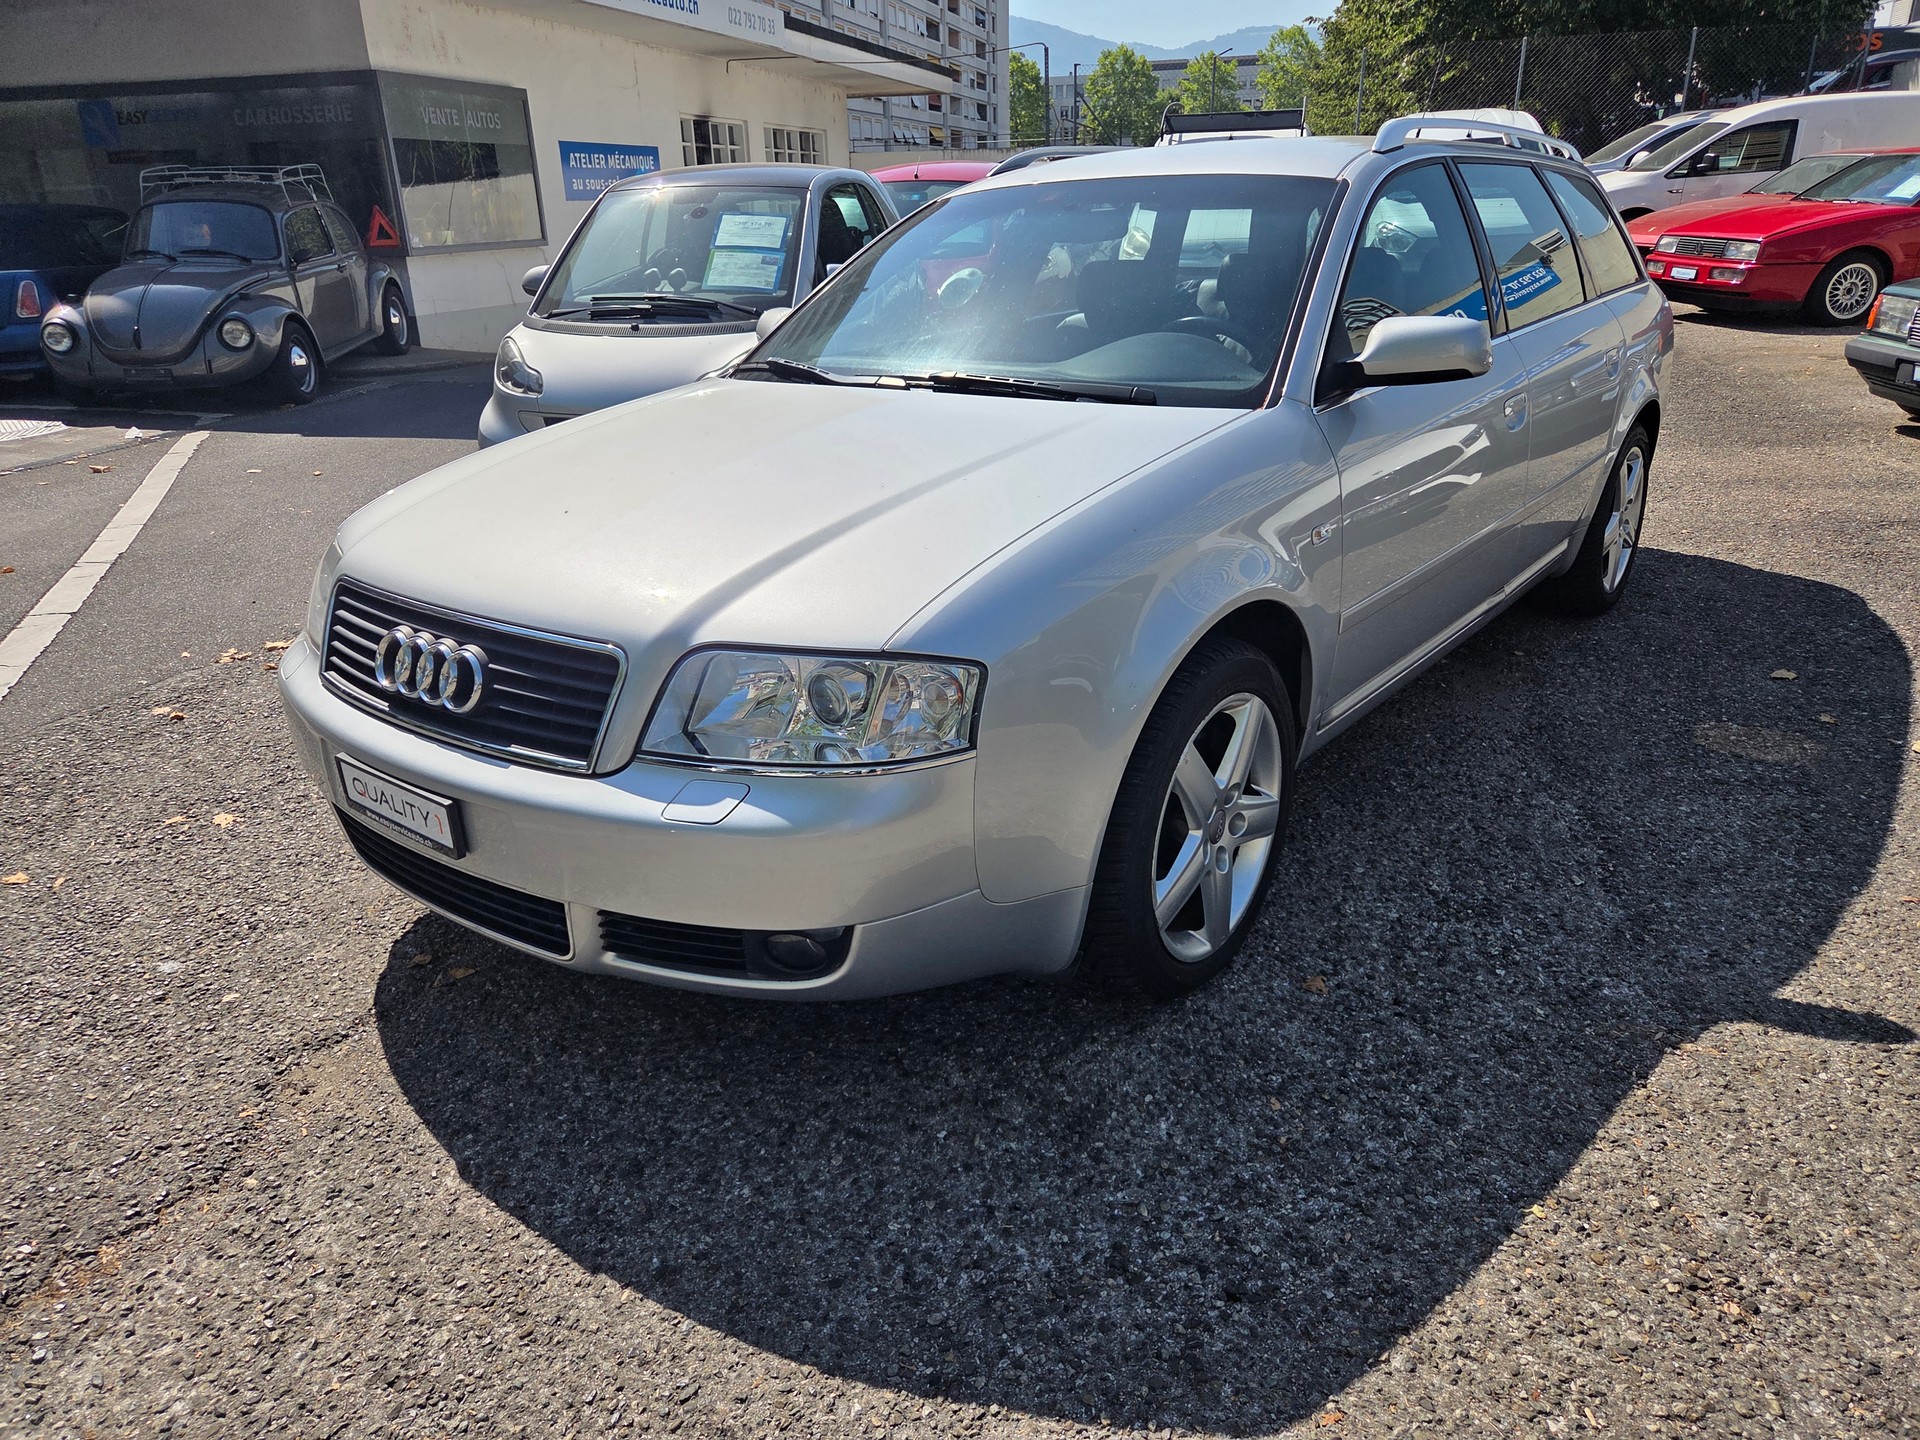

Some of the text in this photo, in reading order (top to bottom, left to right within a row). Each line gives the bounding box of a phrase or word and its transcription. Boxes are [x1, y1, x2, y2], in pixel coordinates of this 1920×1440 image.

[727, 6, 776, 35] 022 792 70 33
[117, 110, 148, 125] EASY
[233, 103, 354, 127] CARROSSERIE
[420, 106, 502, 129] VENTE AUTOS
[569, 151, 655, 172] ATELIER MÉCANIQUE
[572, 178, 584, 190] au
[352, 777, 444, 835] QUALITY 1
[366, 810, 433, 848] www.easyserviceauto.ch
